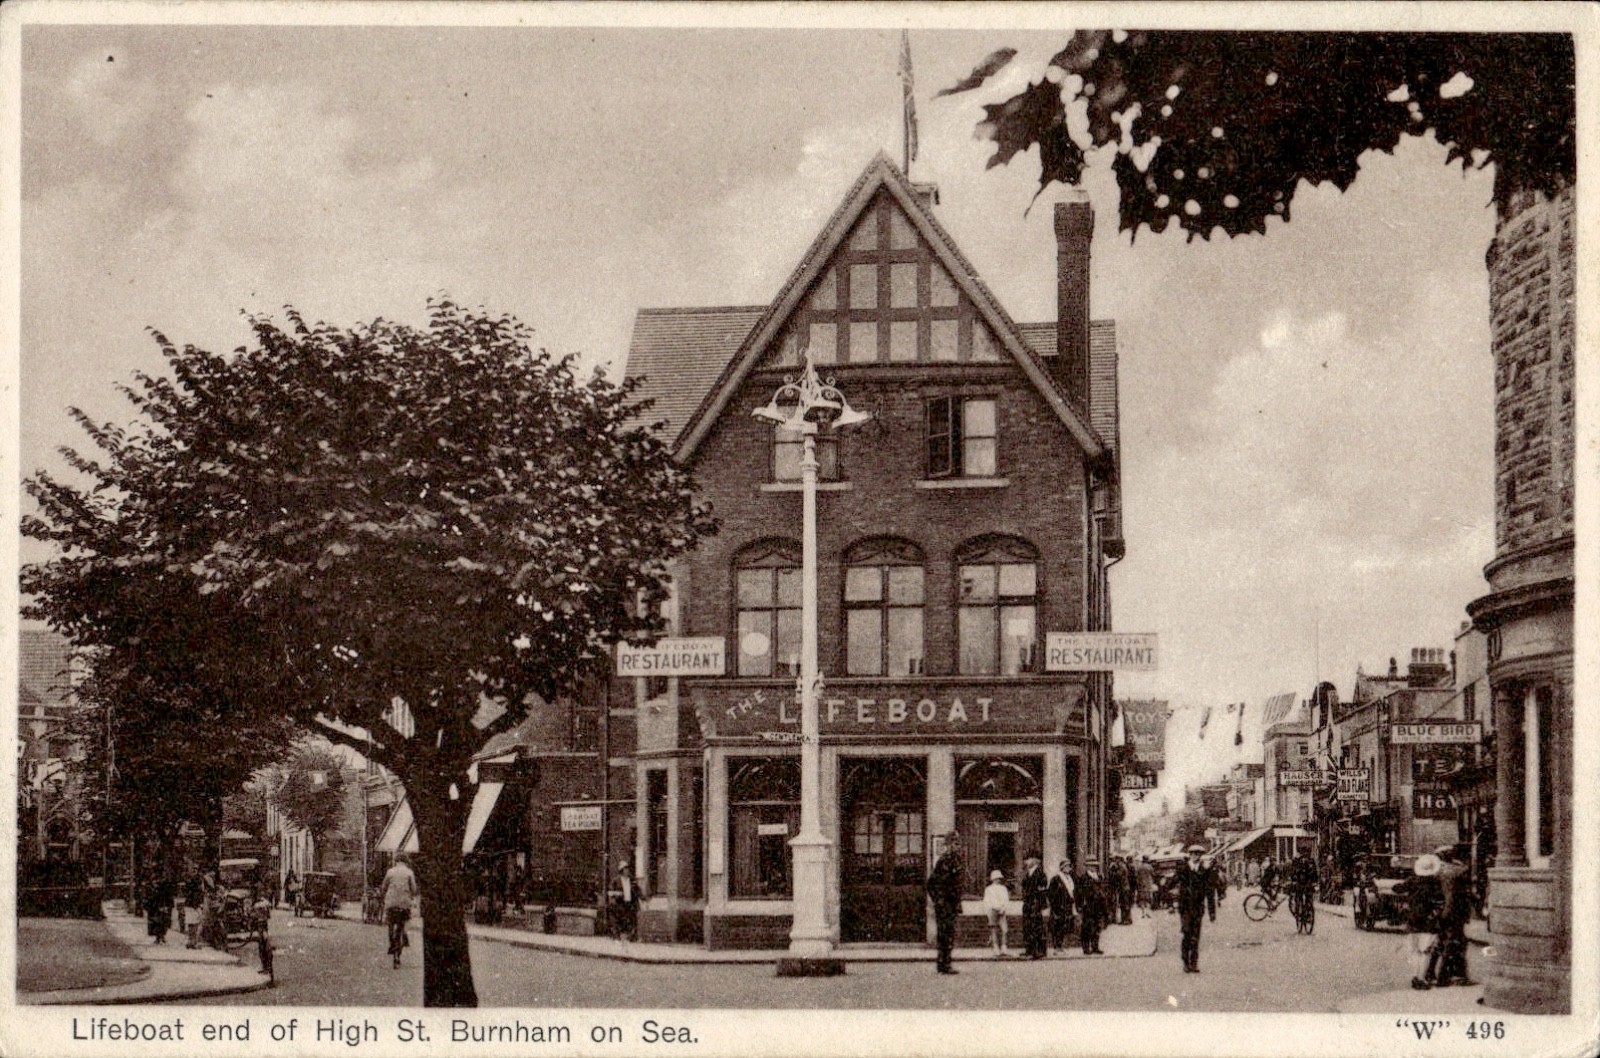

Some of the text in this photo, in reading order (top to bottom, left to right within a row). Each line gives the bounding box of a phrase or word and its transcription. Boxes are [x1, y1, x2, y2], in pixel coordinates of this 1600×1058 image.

[621, 652, 722, 671] RESTAURANT
[1050, 647, 1155, 666] RESTAURANT
[725, 689, 994, 724] THE LFEBOAT
[1440, 725, 1475, 736] BIRD
